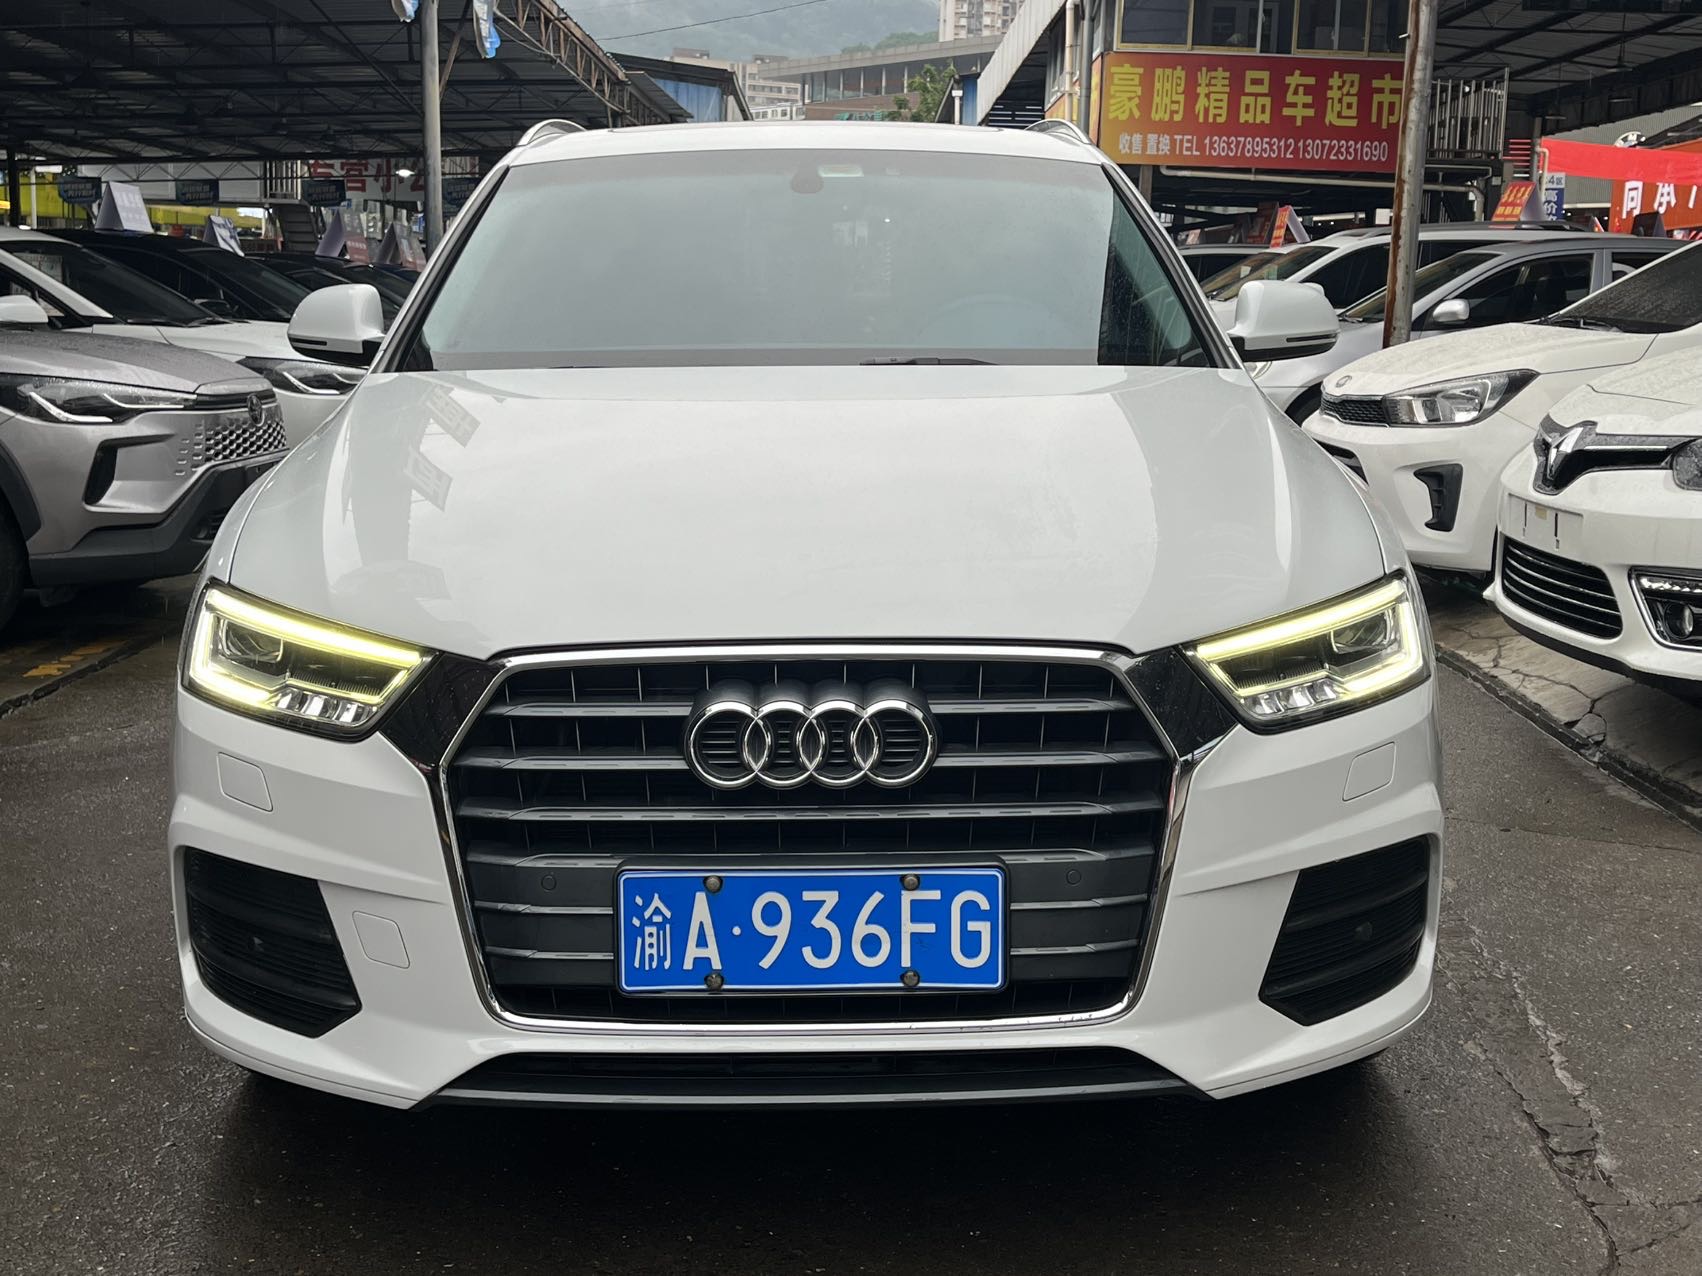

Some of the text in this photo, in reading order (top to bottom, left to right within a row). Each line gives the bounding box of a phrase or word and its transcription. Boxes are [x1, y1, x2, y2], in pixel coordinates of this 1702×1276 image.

[1108, 64, 1404, 129] 豪鹏精品车超市
[1174, 134, 1200, 156] TEL
[1204, 135, 1294, 158] 13637895312
[1298, 138, 1388, 161] 13072331690
[632, 890, 991, 970] 渝A·936FG
